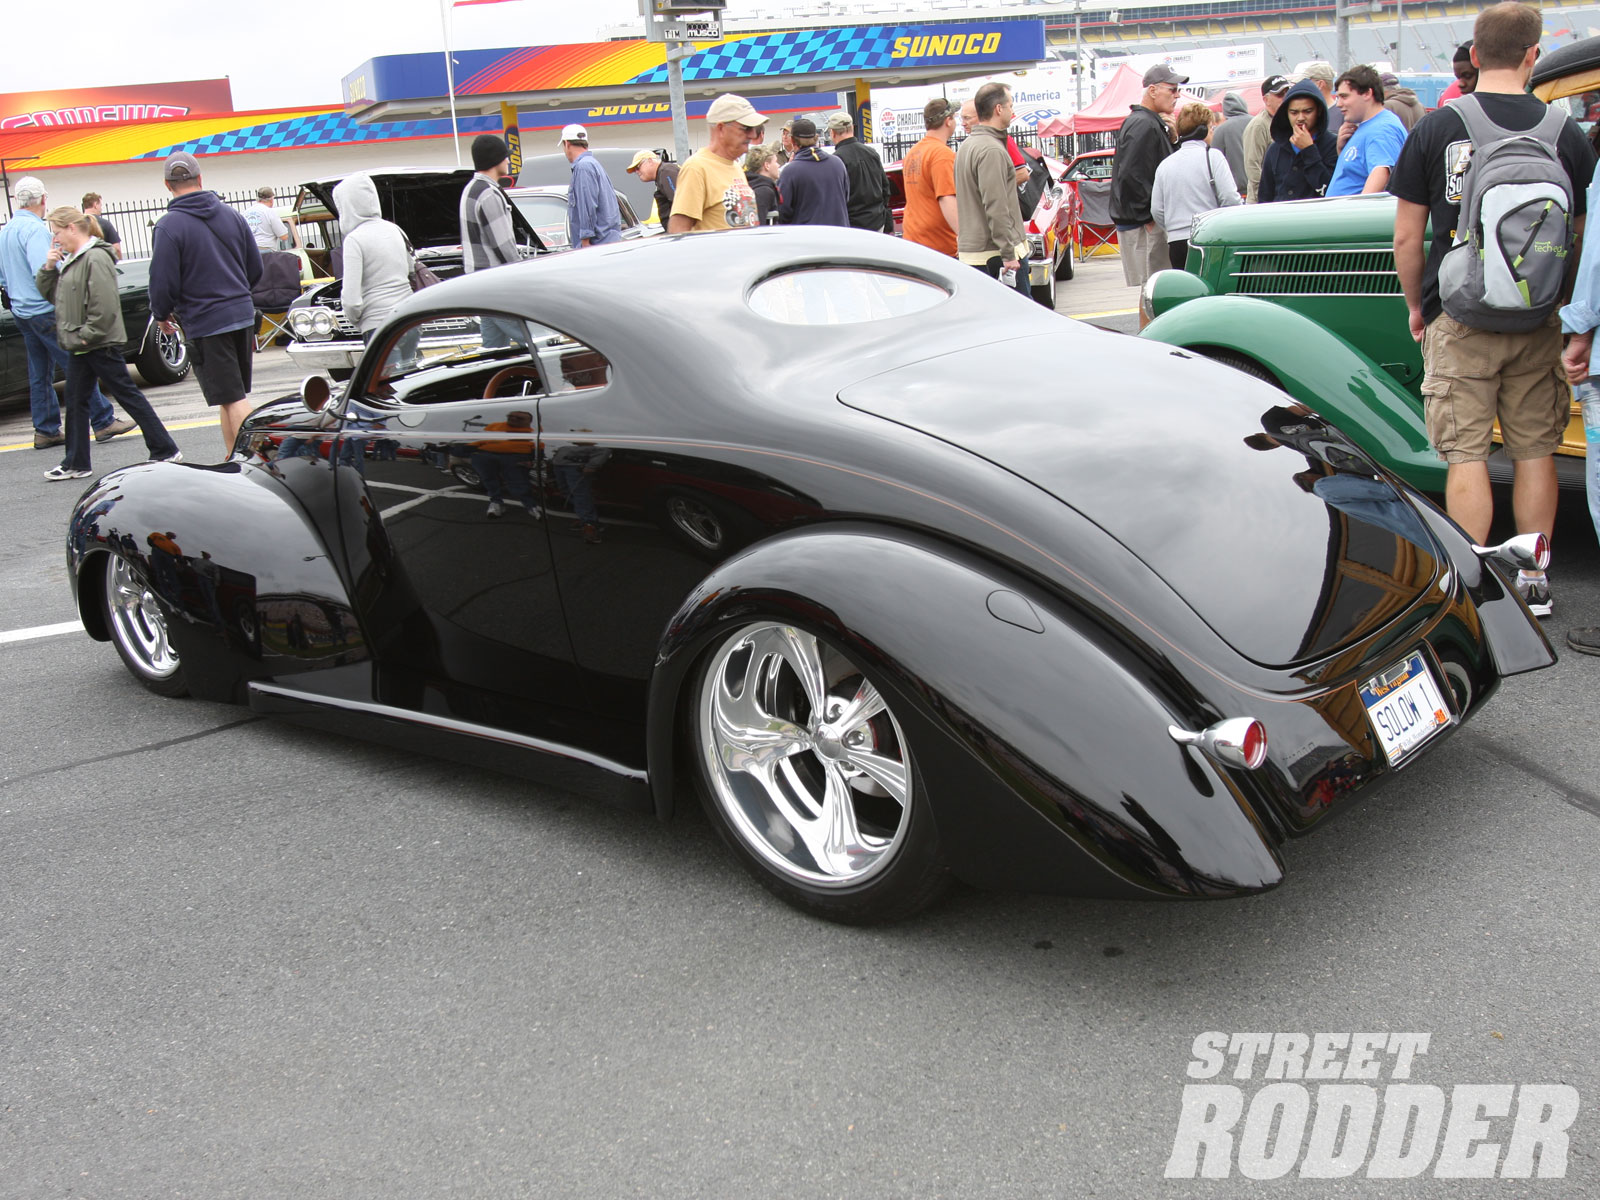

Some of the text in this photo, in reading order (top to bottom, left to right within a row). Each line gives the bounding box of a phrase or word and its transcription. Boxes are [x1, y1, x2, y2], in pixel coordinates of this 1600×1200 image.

[891, 32, 1002, 58] SUNOCO
[1020, 90, 1061, 103] America
[588, 102, 684, 117] SUNOC
[1021, 109, 1061, 126] 500
[897, 112, 924, 127] CHARLOTT
[1377, 690, 1422, 741] SOLOW
[1419, 682, 1434, 711] 1
